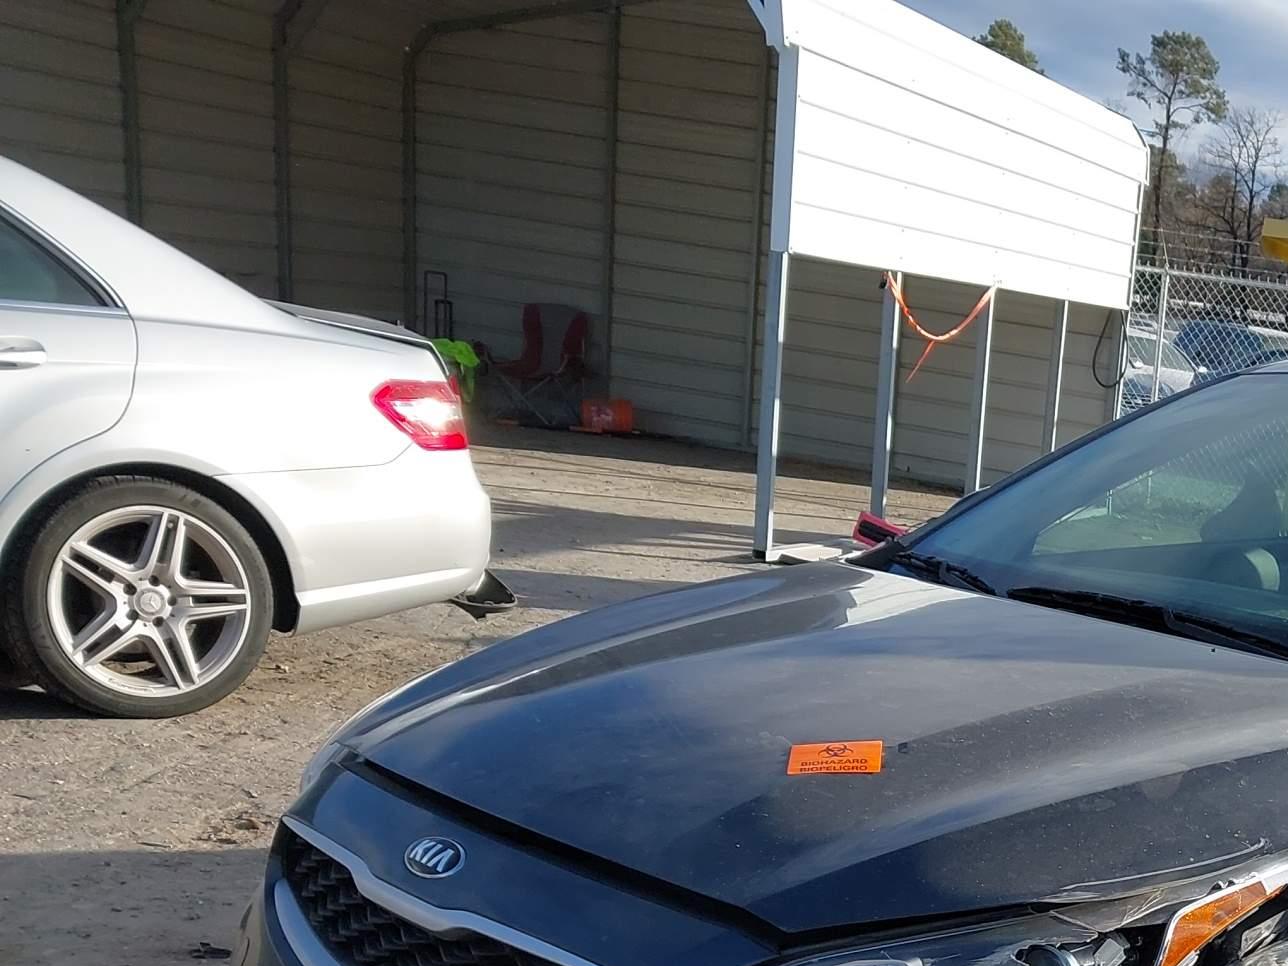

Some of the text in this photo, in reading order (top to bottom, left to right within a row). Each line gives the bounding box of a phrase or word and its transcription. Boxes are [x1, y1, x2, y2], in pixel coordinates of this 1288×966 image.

[800, 758, 868, 767] BIOHAZARD
[799, 765, 868, 773] BIOPELIGRO
[409, 839, 455, 873] KIA
